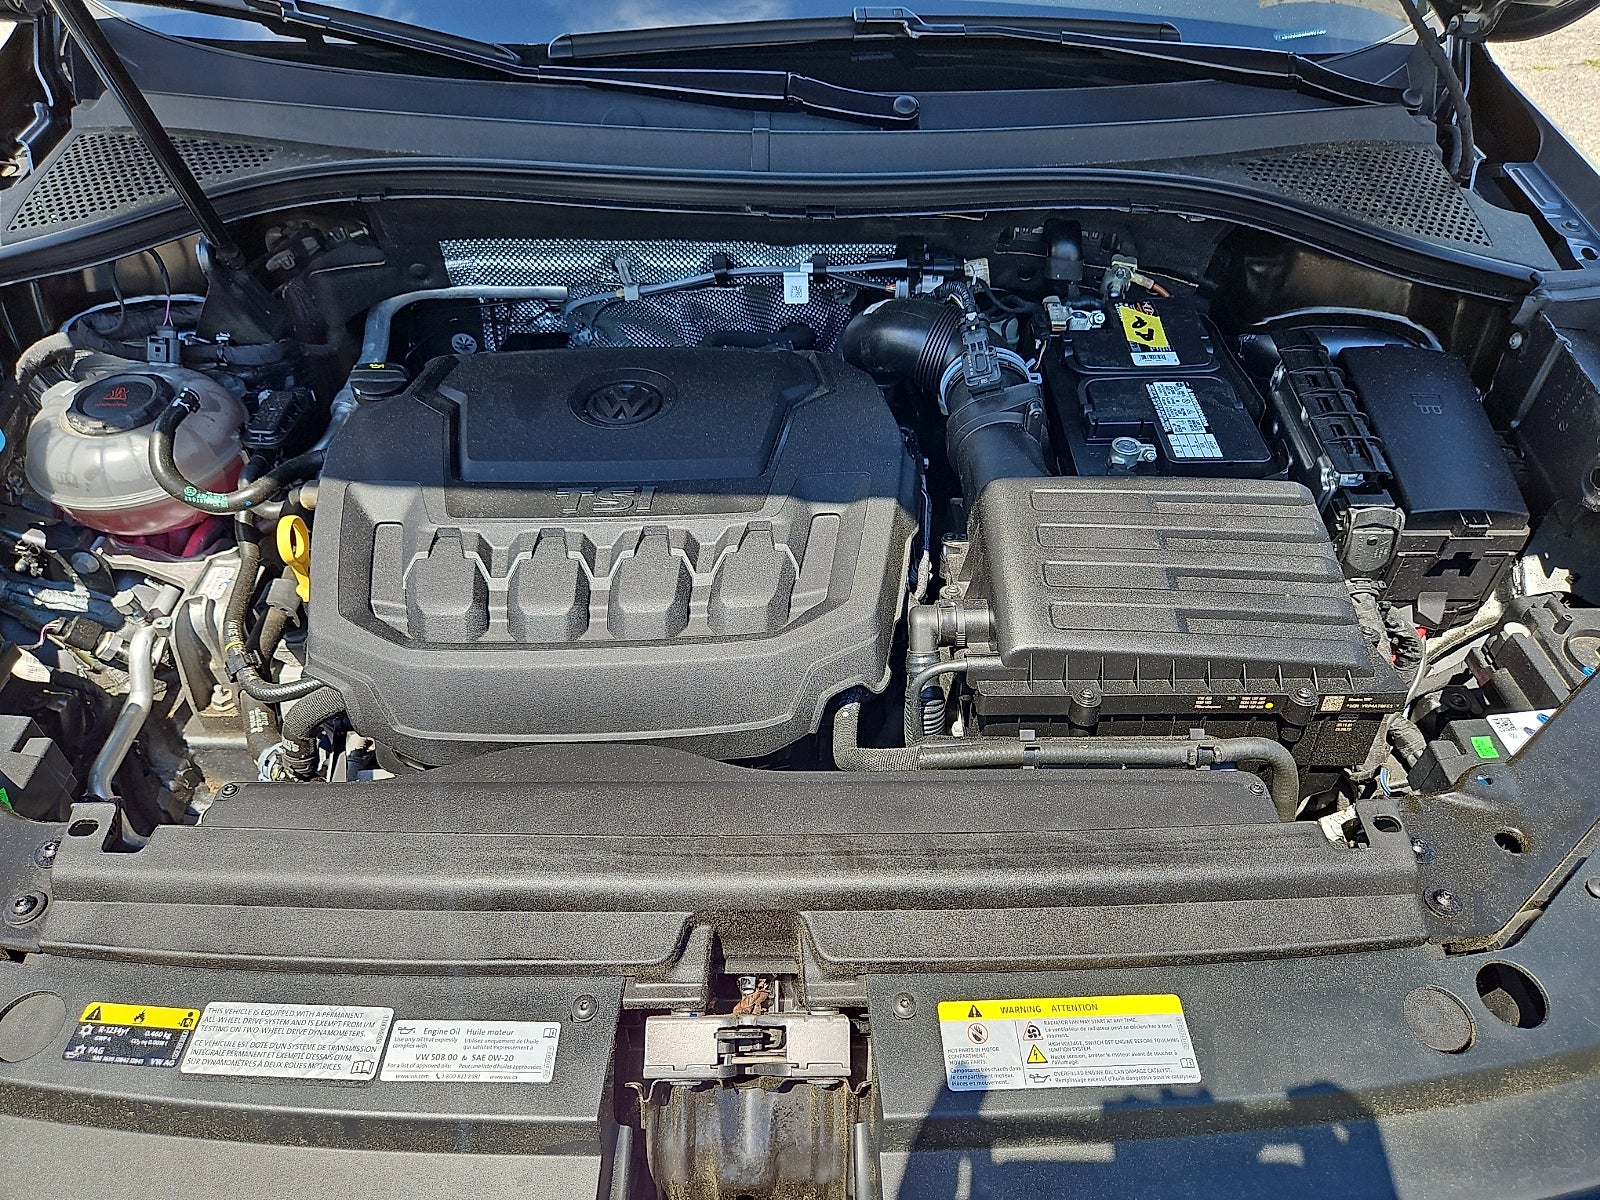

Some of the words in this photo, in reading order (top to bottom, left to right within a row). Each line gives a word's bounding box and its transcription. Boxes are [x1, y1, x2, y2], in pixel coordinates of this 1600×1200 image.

[556, 485, 659, 512] TSI
[1000, 1005, 1042, 1014] WARNING
[1051, 1004, 1098, 1012] ATTENTION
[98, 1026, 130, 1036] R-1234yf
[163, 1031, 172, 1039] kg
[308, 1029, 366, 1037] DYNAMOMETERS.
[424, 1028, 449, 1036] Engine
[88, 1046, 105, 1054] PAG
[226, 1049, 268, 1058] PERMANENT
[202, 1058, 257, 1068] DYNAMOMÈTRES
[308, 1062, 342, 1070] MOTRICES.
